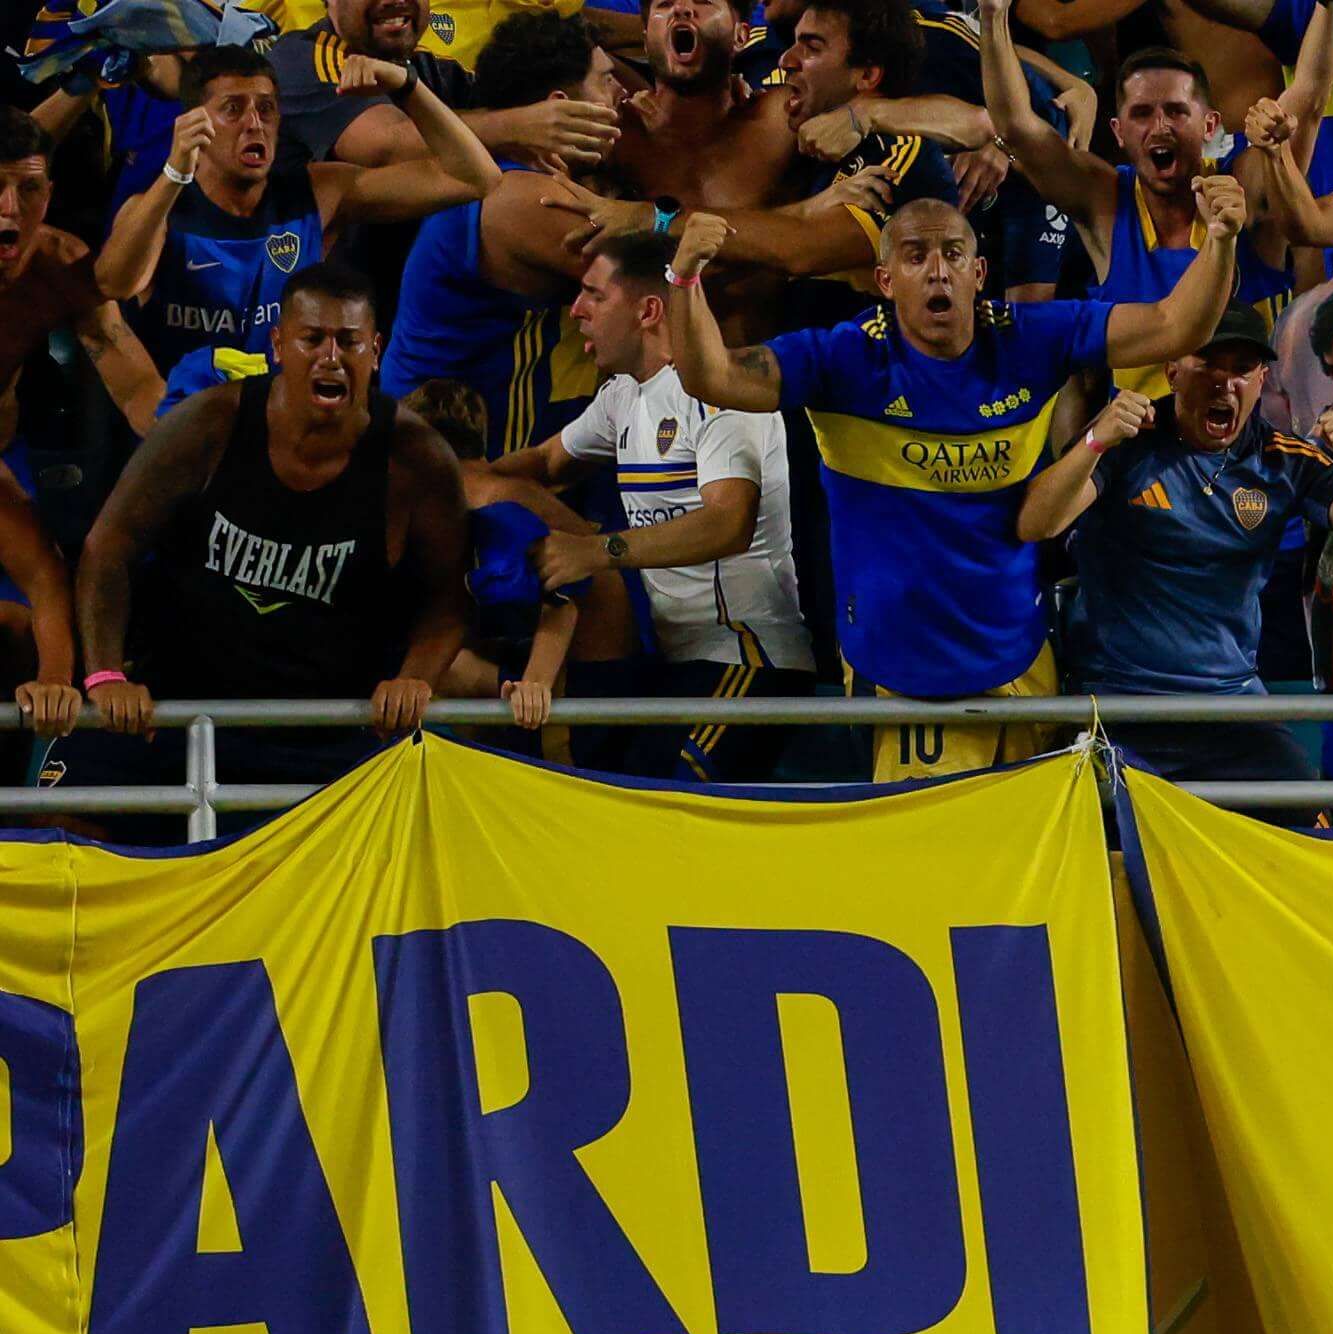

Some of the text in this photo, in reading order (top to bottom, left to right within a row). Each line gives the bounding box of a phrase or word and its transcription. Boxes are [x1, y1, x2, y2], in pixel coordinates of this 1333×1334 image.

[166, 302, 236, 334] BBVA
[901, 439, 1012, 471] QATAR
[929, 465, 1010, 484] AIRWAYS
[205, 510, 355, 604] EVERLAST
